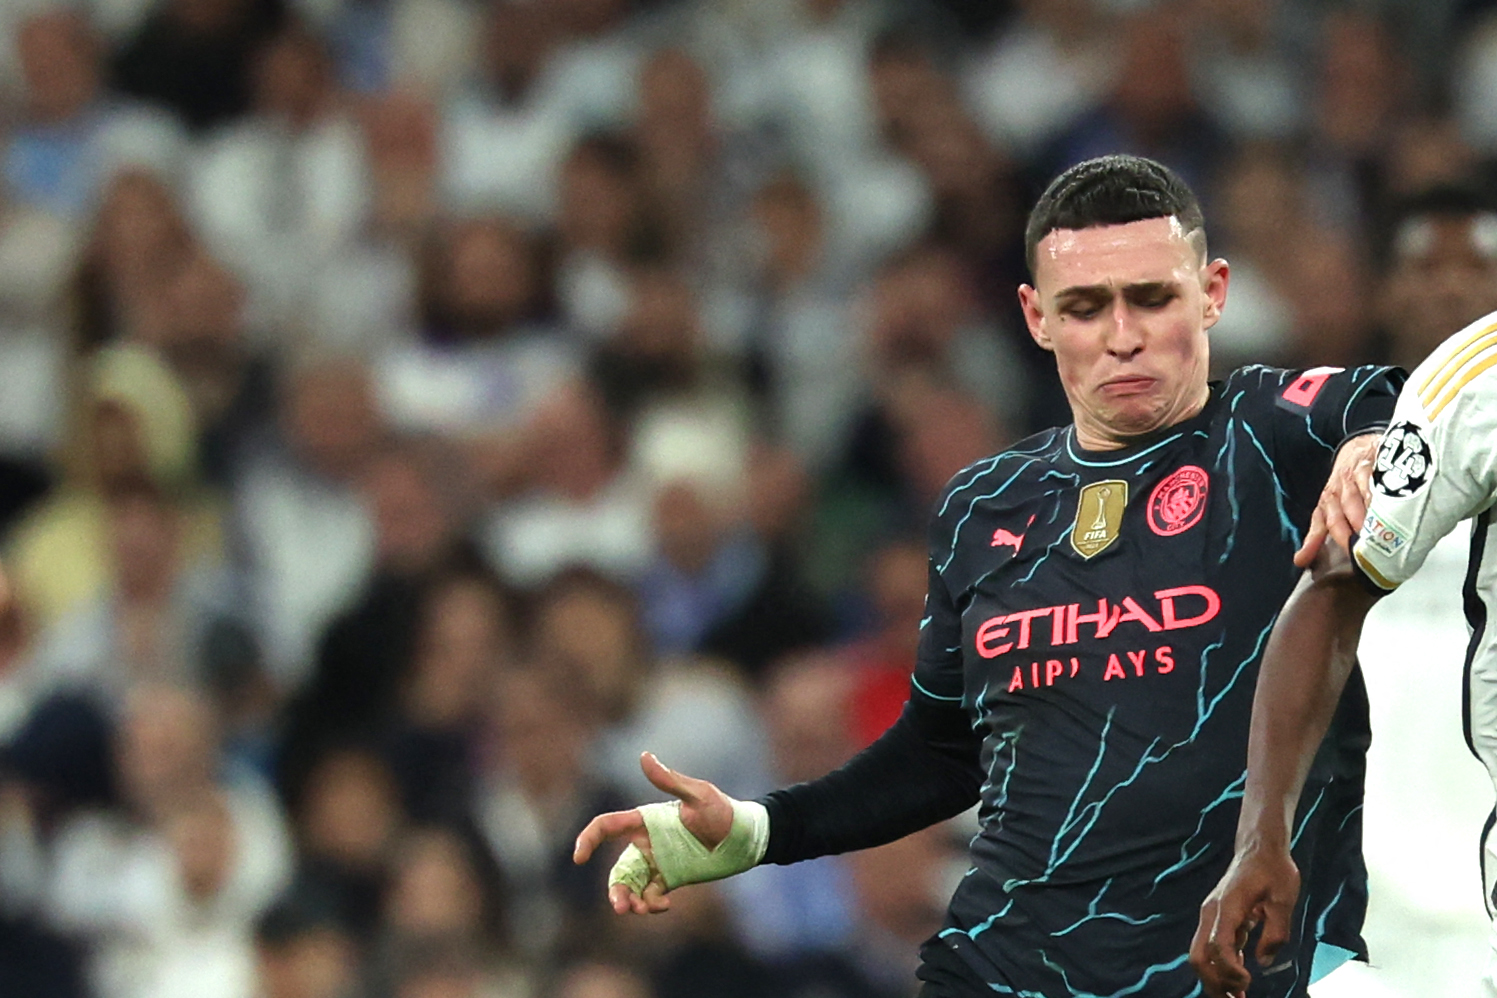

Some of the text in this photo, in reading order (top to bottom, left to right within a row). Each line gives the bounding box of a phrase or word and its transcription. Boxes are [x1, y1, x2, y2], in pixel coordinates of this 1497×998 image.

[1083, 529, 1107, 541] FIFA
[1365, 515, 1404, 548] ATION
[975, 584, 1222, 659] ETIHAD
